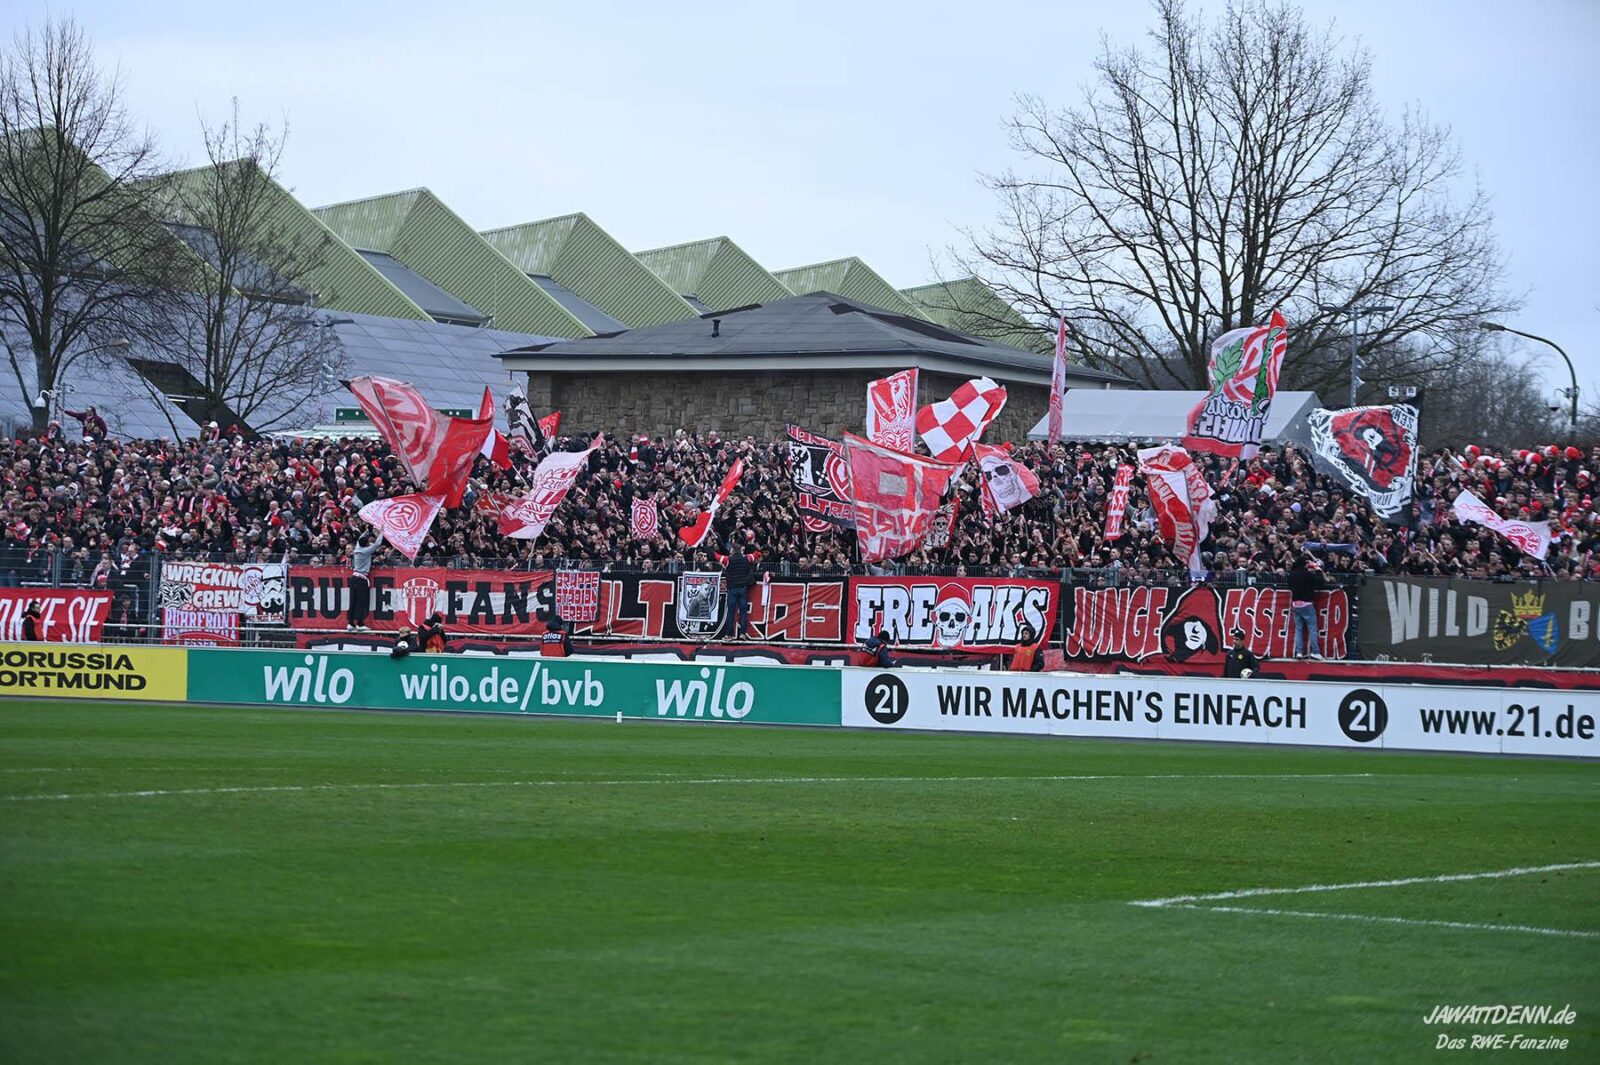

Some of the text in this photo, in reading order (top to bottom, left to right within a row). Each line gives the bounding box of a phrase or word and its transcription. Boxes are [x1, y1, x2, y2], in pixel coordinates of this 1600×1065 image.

[62, 596, 109, 642] SIE
[193, 590, 239, 609] CREW
[292, 577, 394, 620] RUE
[446, 579, 555, 624] FANS
[556, 588, 598, 605] STADION
[855, 584, 1049, 645] FREAKS
[1383, 580, 1600, 645] WILD B
[165, 607, 237, 640] RUHRFRONT
[1065, 586, 1348, 660] JUNGE ESSEER
[264, 655, 354, 704] wilo
[400, 662, 604, 711] wilo.de/bvb
[655, 667, 754, 719] wilo
[874, 685, 899, 714] 21
[937, 685, 992, 717] WIR
[1174, 693, 1306, 729] EINFACH
[1348, 700, 1376, 732] 21
[1420, 704, 1595, 740] www.21.de
